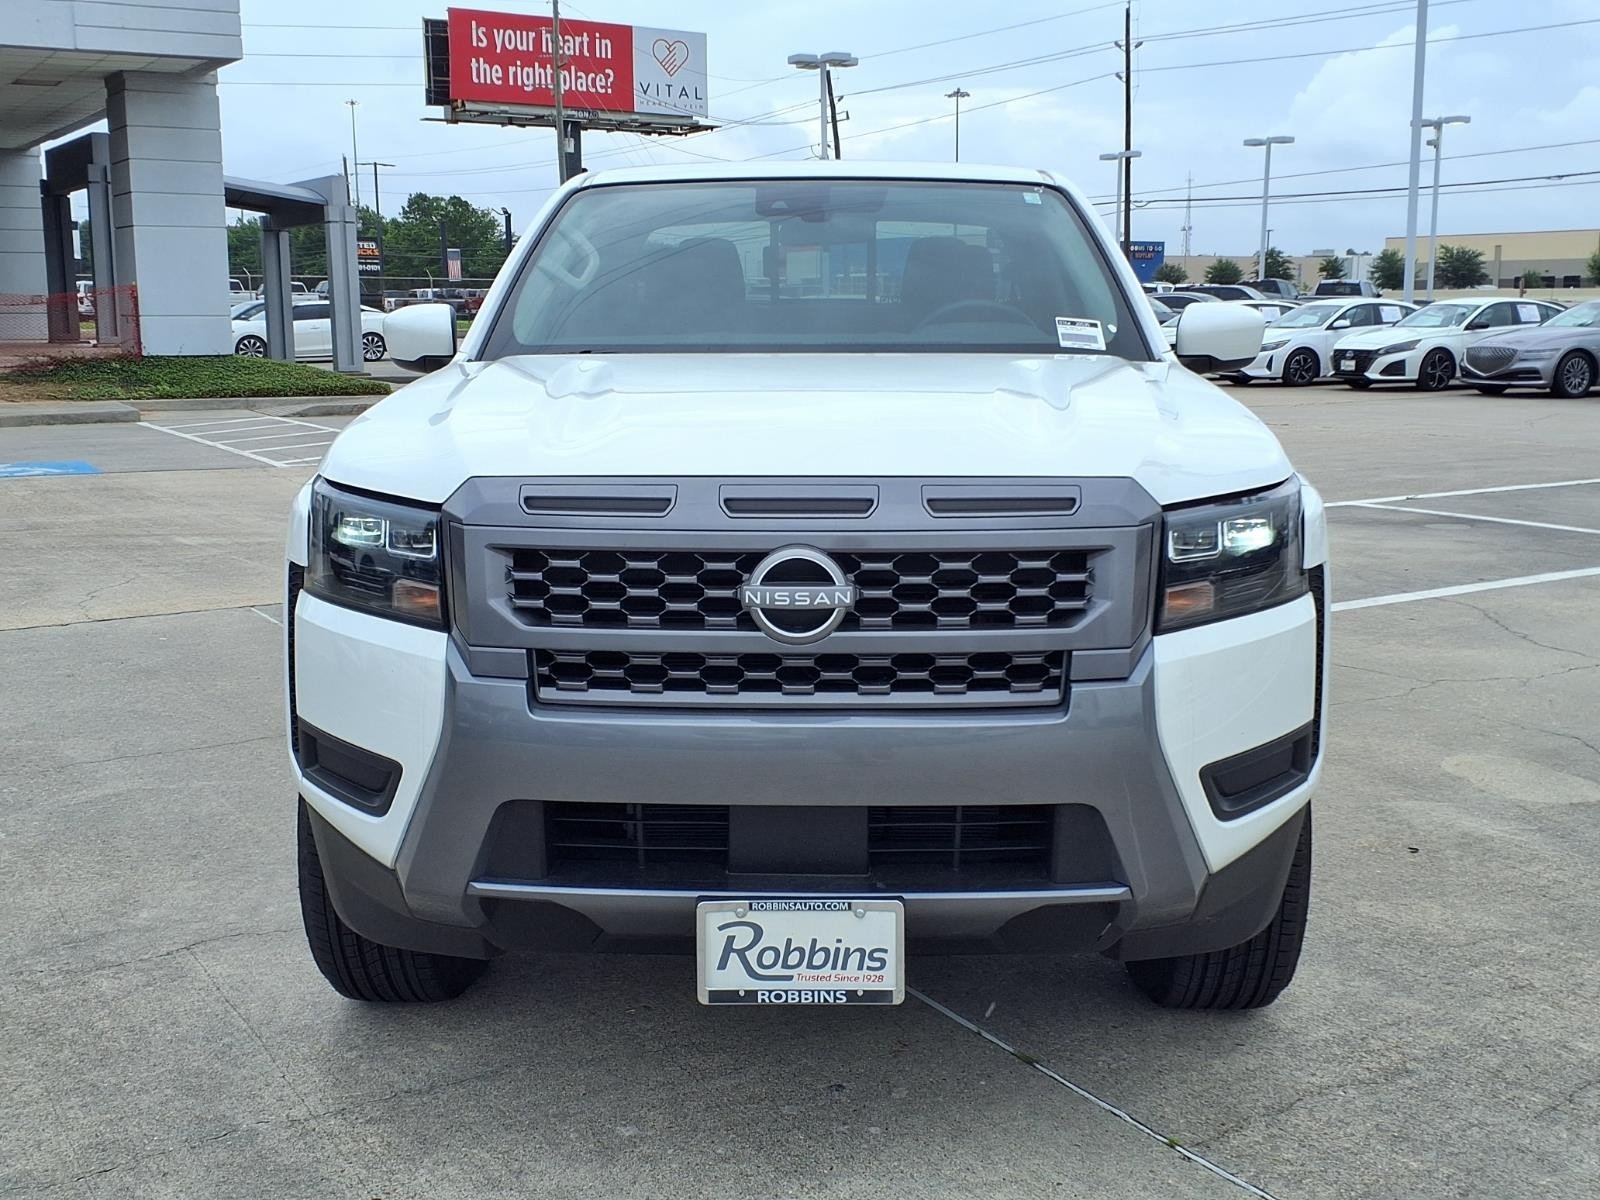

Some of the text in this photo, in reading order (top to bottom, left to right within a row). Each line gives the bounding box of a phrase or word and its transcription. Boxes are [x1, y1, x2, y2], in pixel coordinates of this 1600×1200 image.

[471, 20, 488, 48] Is
[494, 27, 534, 60] your
[595, 32, 612, 60] in
[470, 57, 614, 95] the right place?
[639, 81, 703, 101] VITAL
[745, 590, 851, 606] NISSAN
[751, 902, 849, 911] ROBBINSAUTO.COM
[716, 920, 889, 982] Robbins
[796, 973, 884, 983] Trusted Since 1928
[757, 990, 847, 1004] ROBBINS
